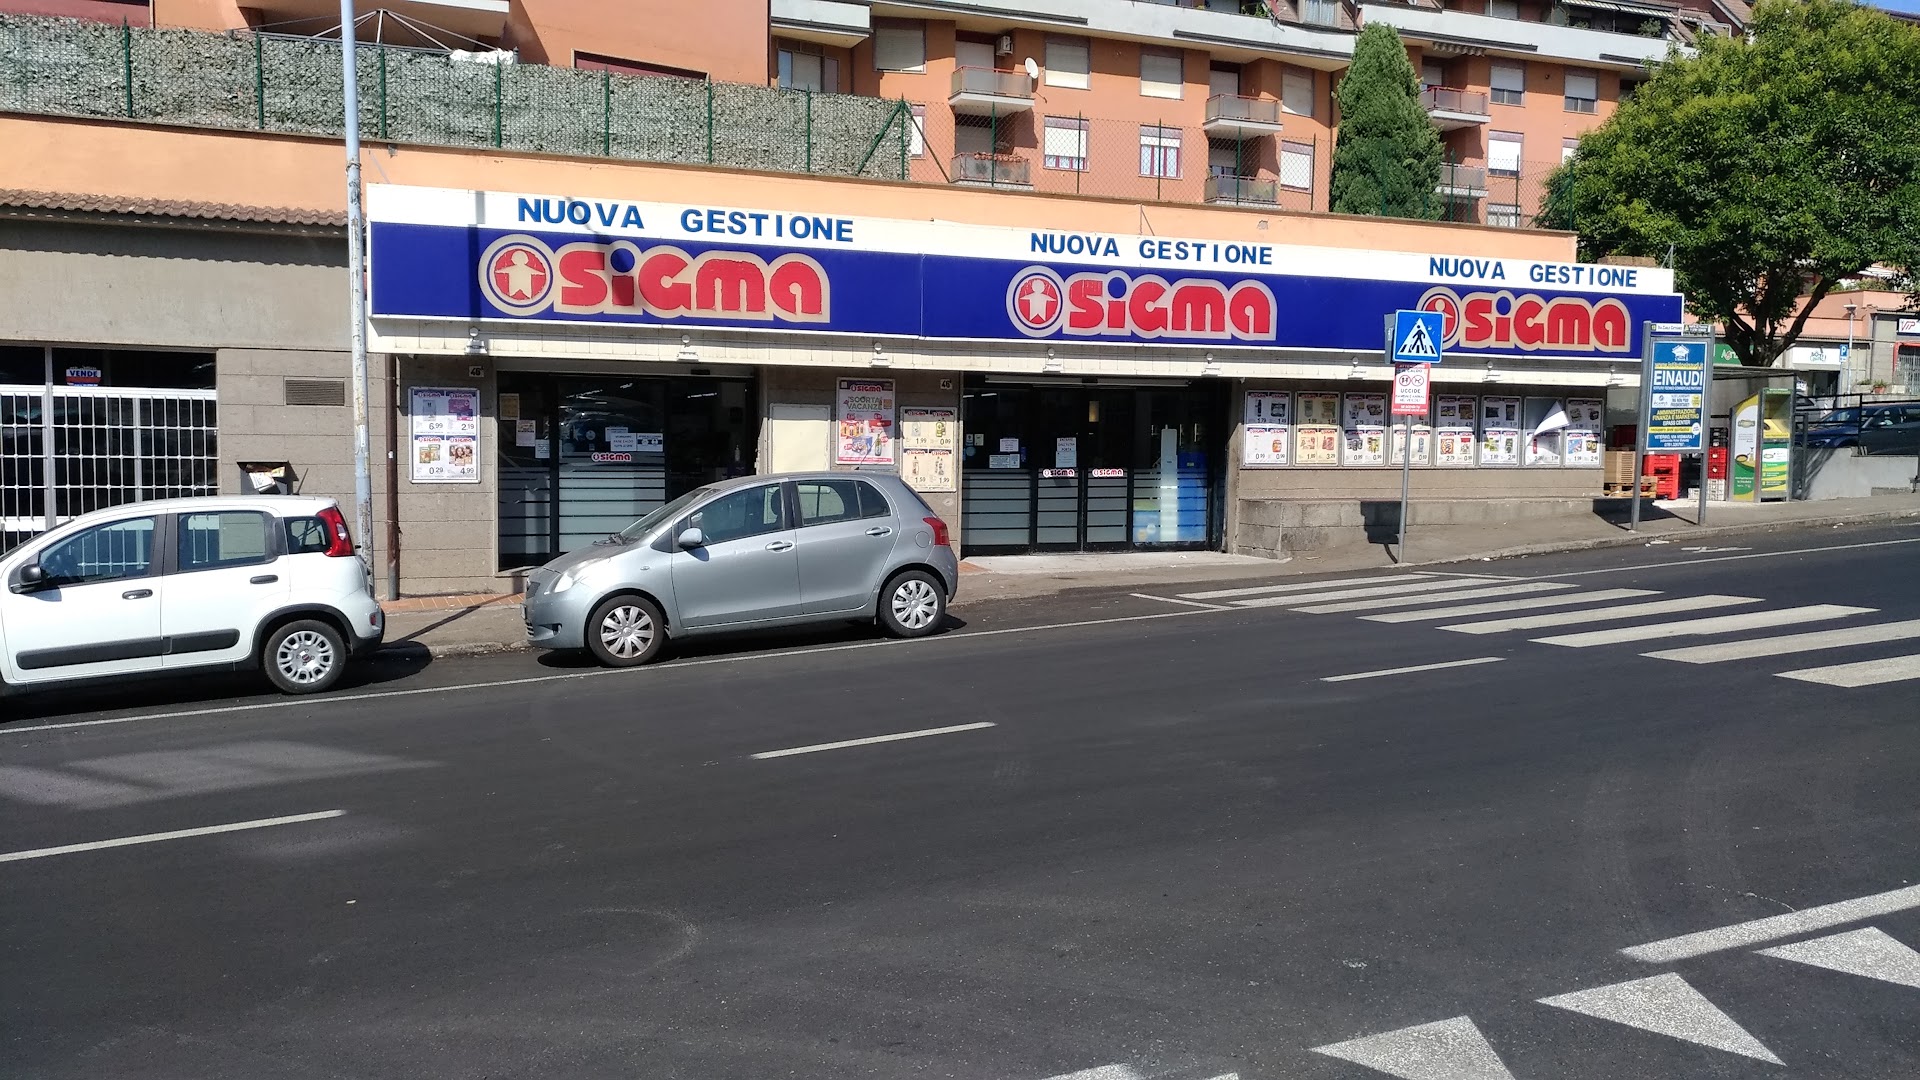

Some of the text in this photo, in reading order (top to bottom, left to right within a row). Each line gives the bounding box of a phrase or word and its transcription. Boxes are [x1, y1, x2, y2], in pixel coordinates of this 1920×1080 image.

[517, 197, 854, 243] NUOVA GESTIONE
[1030, 232, 1273, 265] NUOVA GESTIONE
[1429, 257, 1637, 287] NUOVA GESTIONE
[1653, 370, 1703, 386] EINAUDI
